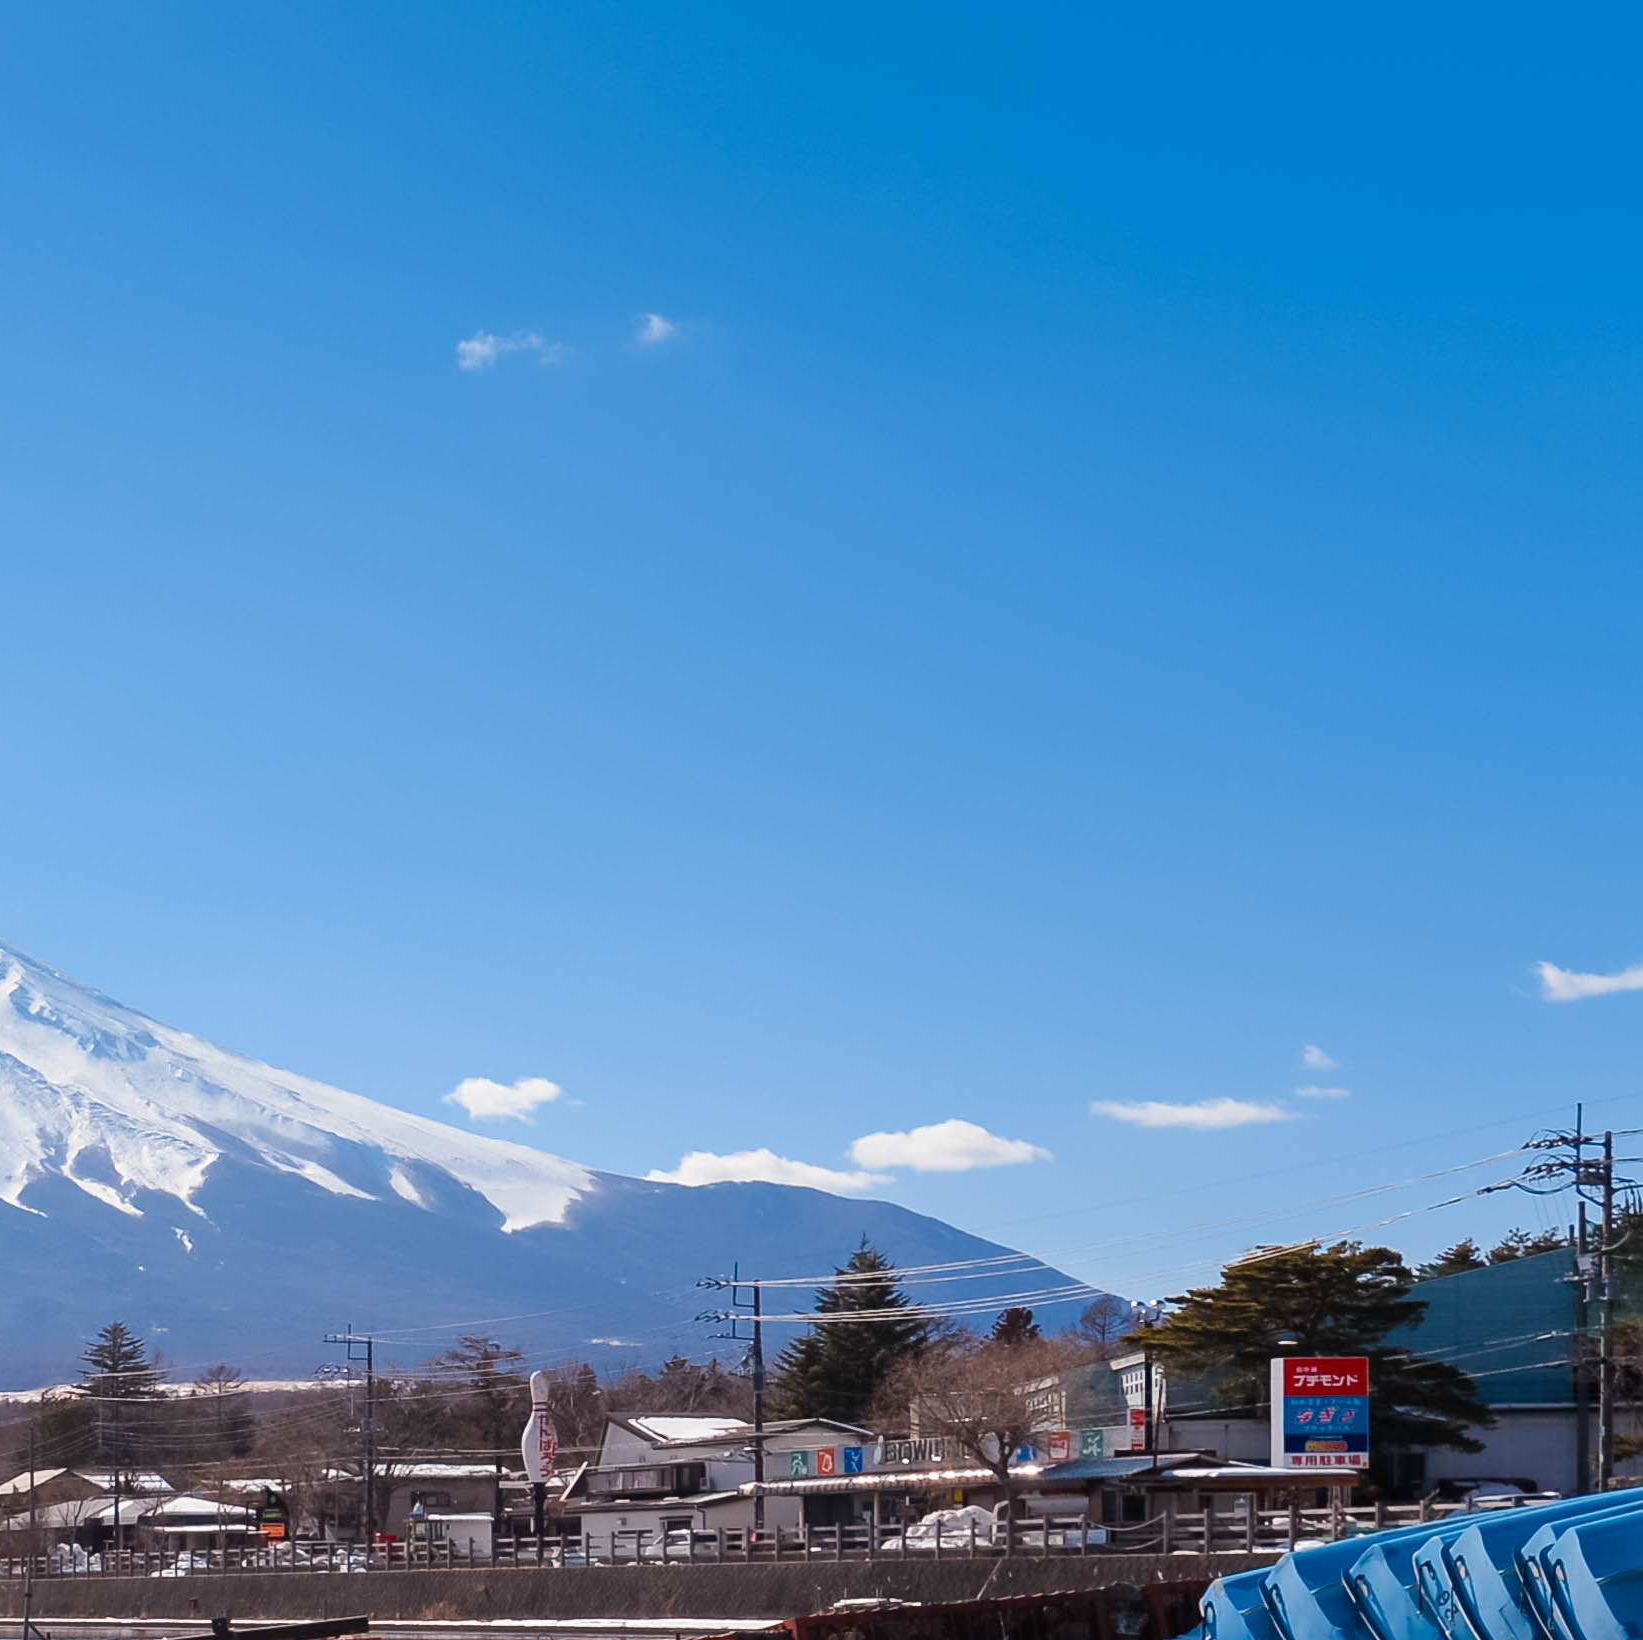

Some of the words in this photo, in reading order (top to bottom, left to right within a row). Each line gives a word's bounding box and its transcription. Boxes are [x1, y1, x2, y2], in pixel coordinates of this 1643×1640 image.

[1292, 1374, 1359, 1387] プチモンド
